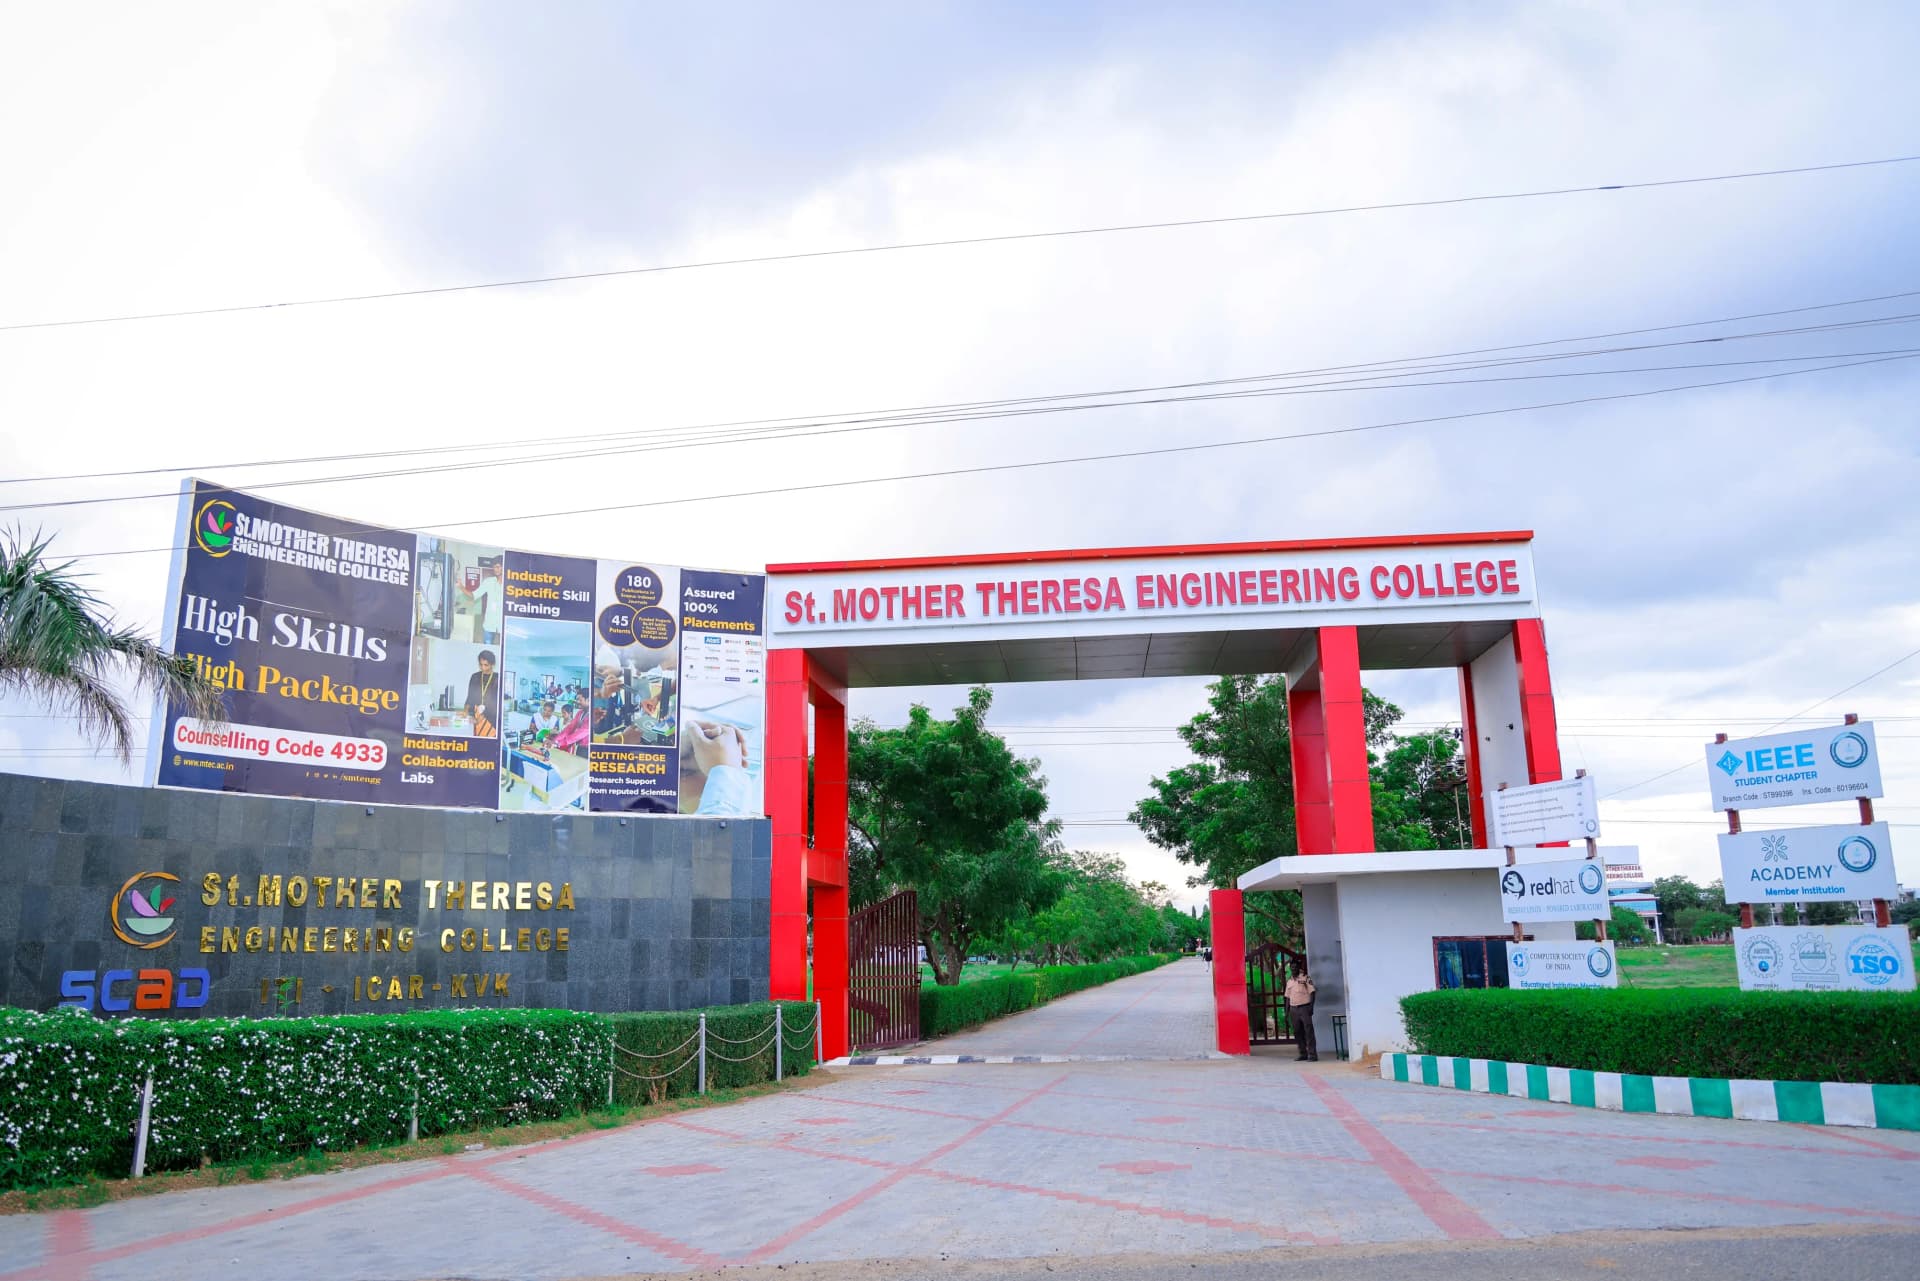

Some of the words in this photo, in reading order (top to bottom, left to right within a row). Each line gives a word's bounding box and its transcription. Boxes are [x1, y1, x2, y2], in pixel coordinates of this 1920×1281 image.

[235, 512, 329, 557] St.MOTHER
[332, 536, 410, 571] THERESA
[232, 536, 337, 573] ENGINEERING
[339, 563, 409, 586] COLLEGE
[507, 569, 562, 585] Industry
[627, 575, 651, 588] 180
[506, 586, 559, 599] Specific
[562, 591, 590, 602] Skill
[684, 586, 735, 600] Assured
[976, 577, 1126, 616] THERESA
[1136, 566, 1360, 609] ENGINEERING
[1370, 559, 1520, 600] COLLEGE
[506, 601, 561, 617] Training
[684, 602, 719, 614] 100%
[183, 594, 259, 646] High
[272, 612, 388, 661] Skills
[611, 615, 629, 626] 45
[683, 616, 755, 631] Placements
[258, 665, 400, 715] Package
[177, 725, 269, 756] Counselling
[276, 737, 324, 757] Code
[331, 742, 384, 763] 4933
[403, 737, 468, 752] Industrial
[402, 754, 495, 770] Collaboration
[590, 751, 666, 762] CUTTING-EDGE
[1745, 743, 1816, 772] IEEE
[589, 762, 666, 775] RESEARCH
[401, 772, 434, 784] Labs
[588, 776, 624, 784] Research
[625, 777, 656, 785] Support
[1735, 775, 1773, 787] STUDENT
[1775, 771, 1818, 783] CHAPTER
[609, 788, 639, 796] reputed
[1743, 793, 1758, 801] Code
[1815, 786, 1831, 794] Code
[1750, 865, 1834, 882] ACADEMY
[424, 880, 575, 911] THERESA
[1765, 887, 1799, 896] Member
[1801, 886, 1846, 895] Institution
[200, 926, 415, 953] ENGINEERING
[440, 928, 570, 953] COLLEGE
[1851, 955, 1899, 975] ISO
